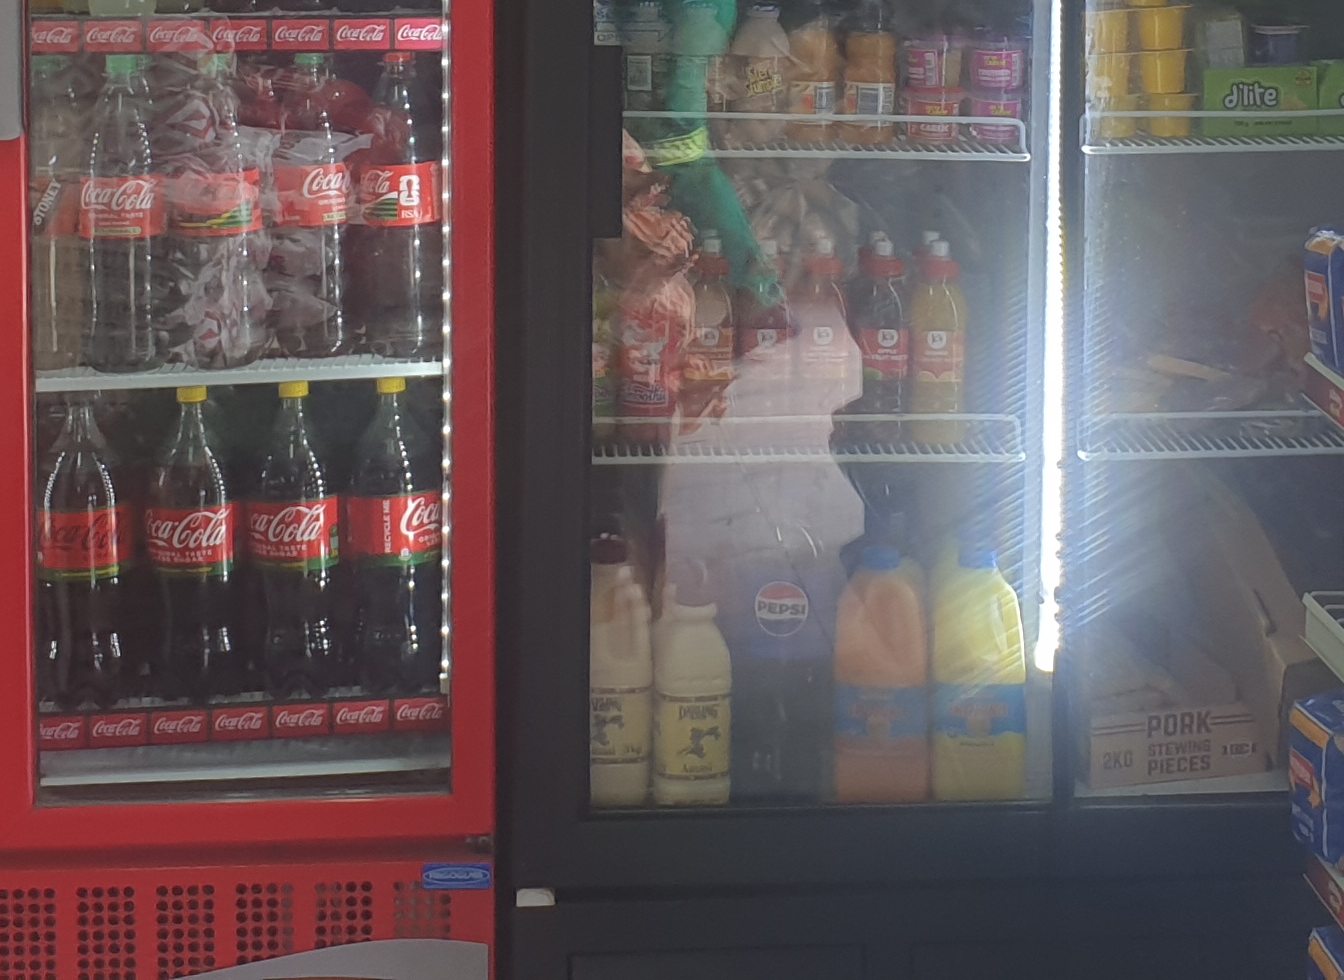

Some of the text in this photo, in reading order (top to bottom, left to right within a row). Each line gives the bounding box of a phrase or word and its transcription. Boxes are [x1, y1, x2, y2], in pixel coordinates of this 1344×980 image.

[85, 26, 138, 44] Coca-Cola
[274, 25, 326, 43] Coca-Cola
[336, 24, 387, 43] Coca-Cola
[81, 180, 159, 211] Coca-Cola
[757, 600, 806, 615] PEPSI
[215, 712, 263, 731] Coca-Cola
[276, 709, 325, 728] Coca-Cola
[336, 705, 386, 725] Coca-Cola
[397, 702, 445, 722] Coca-Cola
[92, 719, 141, 738] Coca-Cola
[154, 715, 204, 735] Coca-Cola
[1147, 710, 1212, 739] PORK
[1148, 739, 1211, 758] STEWING
[1147, 755, 1212, 777] PIECES
